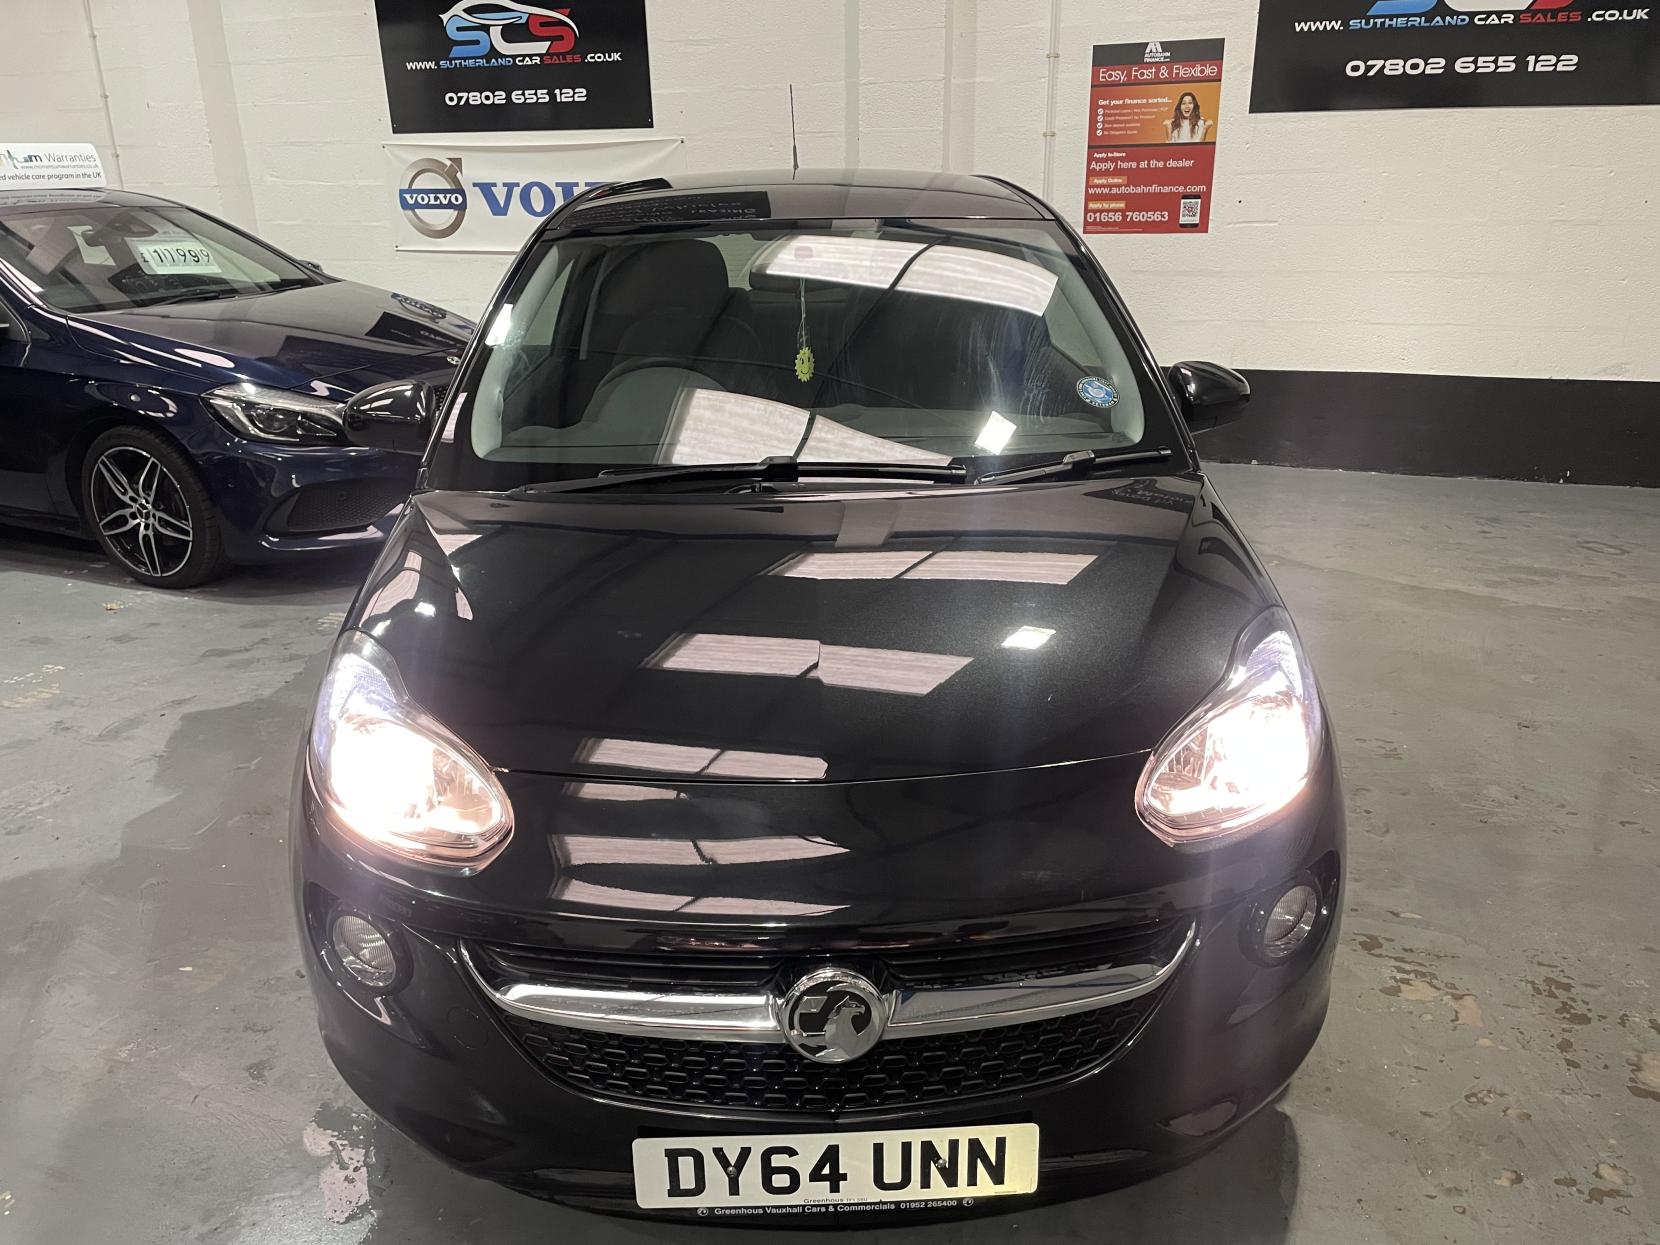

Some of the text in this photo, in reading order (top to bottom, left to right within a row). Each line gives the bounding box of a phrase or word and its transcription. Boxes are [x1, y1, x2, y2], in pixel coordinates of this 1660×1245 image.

[1294, 8, 1650, 32] WWW. SUTHERLAND CAR SALES .CO.UK
[406, 52, 622, 71] WWW. SUTHERLAND CAR SALES .CO.UK
[1345, 54, 1579, 77] 07802 655 122
[1099, 64, 1218, 83] Easy, Fast & Flexible
[444, 88, 587, 106] 07802 655 122
[44, 152, 96, 163] Warranties
[1089, 158, 1195, 171] Apply here at the dealer
[8, 172, 31, 181] vehicle
[47, 173, 74, 181] program
[92, 171, 102, 179] UK
[1088, 184, 1206, 194] www.autobahnfinance.com
[402, 193, 463, 206] VOLVO
[1087, 212, 1122, 222] 01656
[1126, 211, 1169, 222] 760563
[663, 1136, 1007, 1198] DY64 UNN
[714, 1200, 957, 1216] Greenhous Vauxhall Cars & Commercials 01952 265400
[803, 1197, 844, 1205] Greenhous
